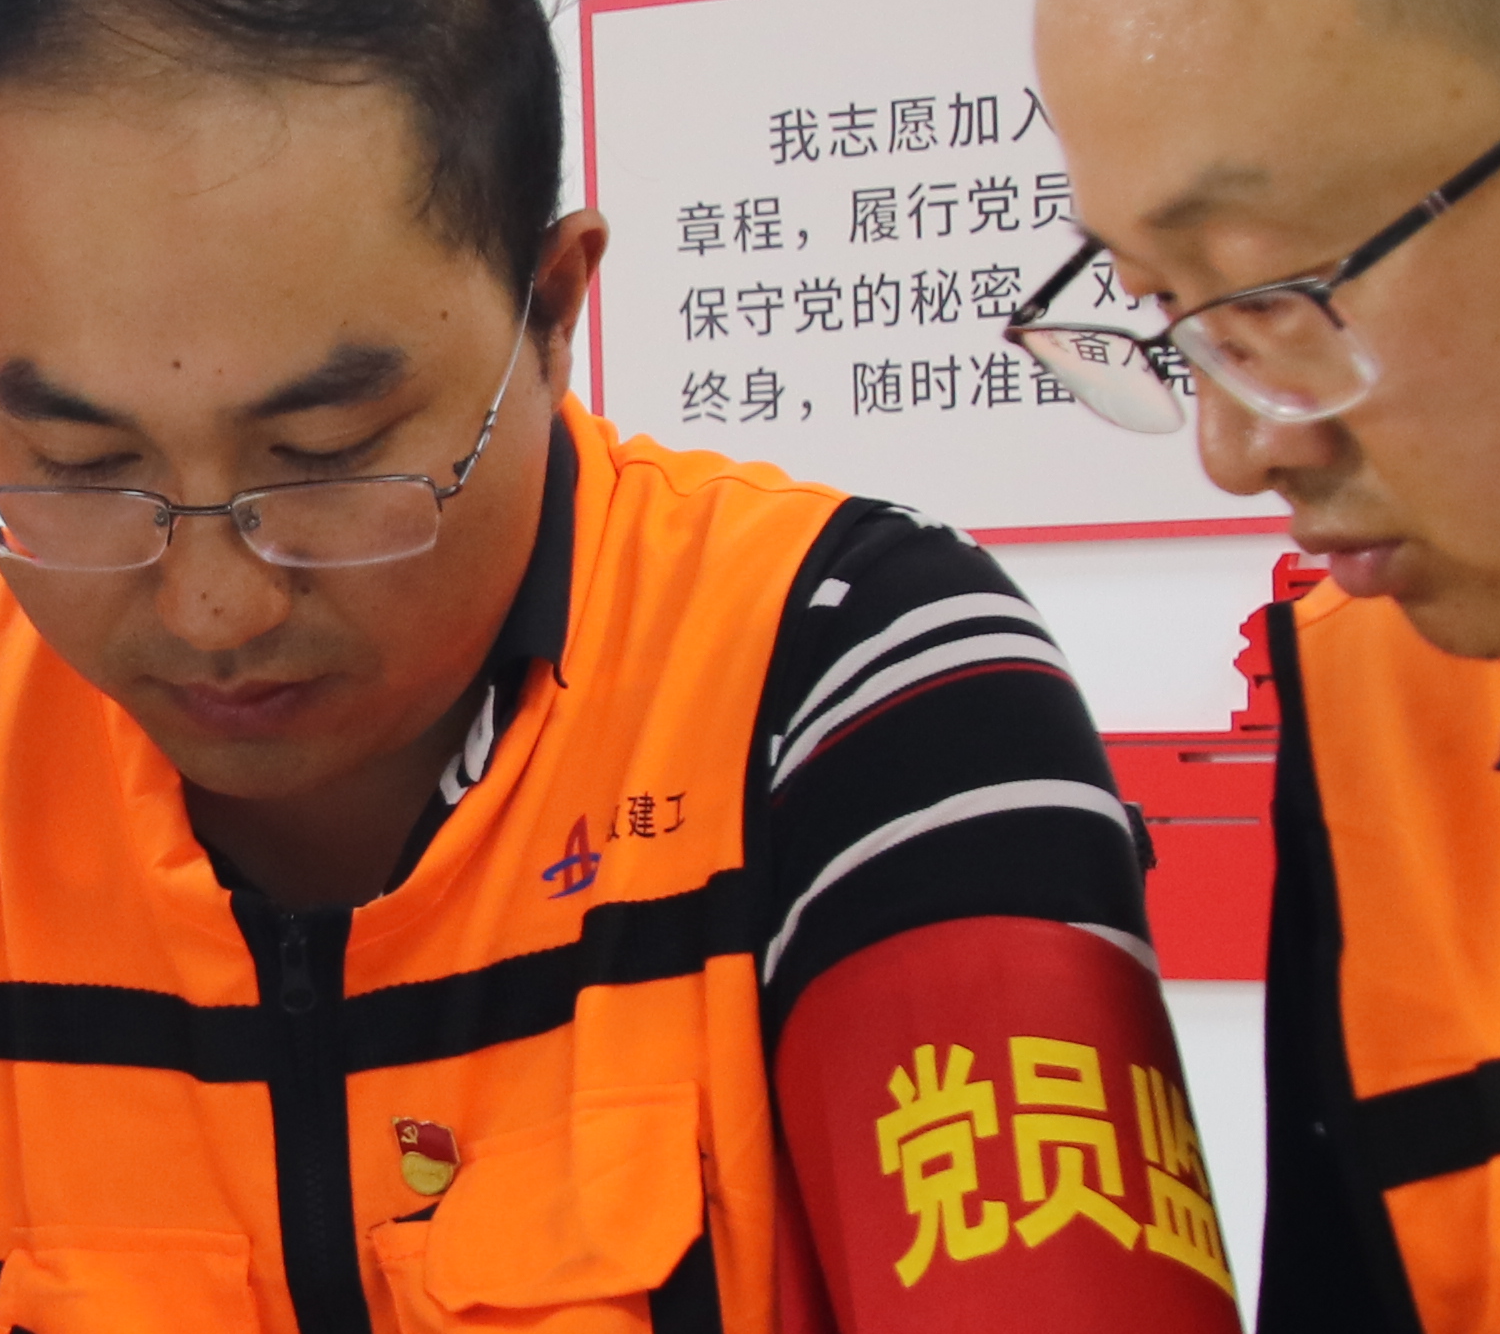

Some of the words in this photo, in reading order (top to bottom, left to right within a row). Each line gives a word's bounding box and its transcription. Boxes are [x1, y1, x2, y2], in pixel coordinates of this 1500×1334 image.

[769, 86, 1057, 165] 我志愿加入
[676, 171, 1074, 258] 章程，履行党员
